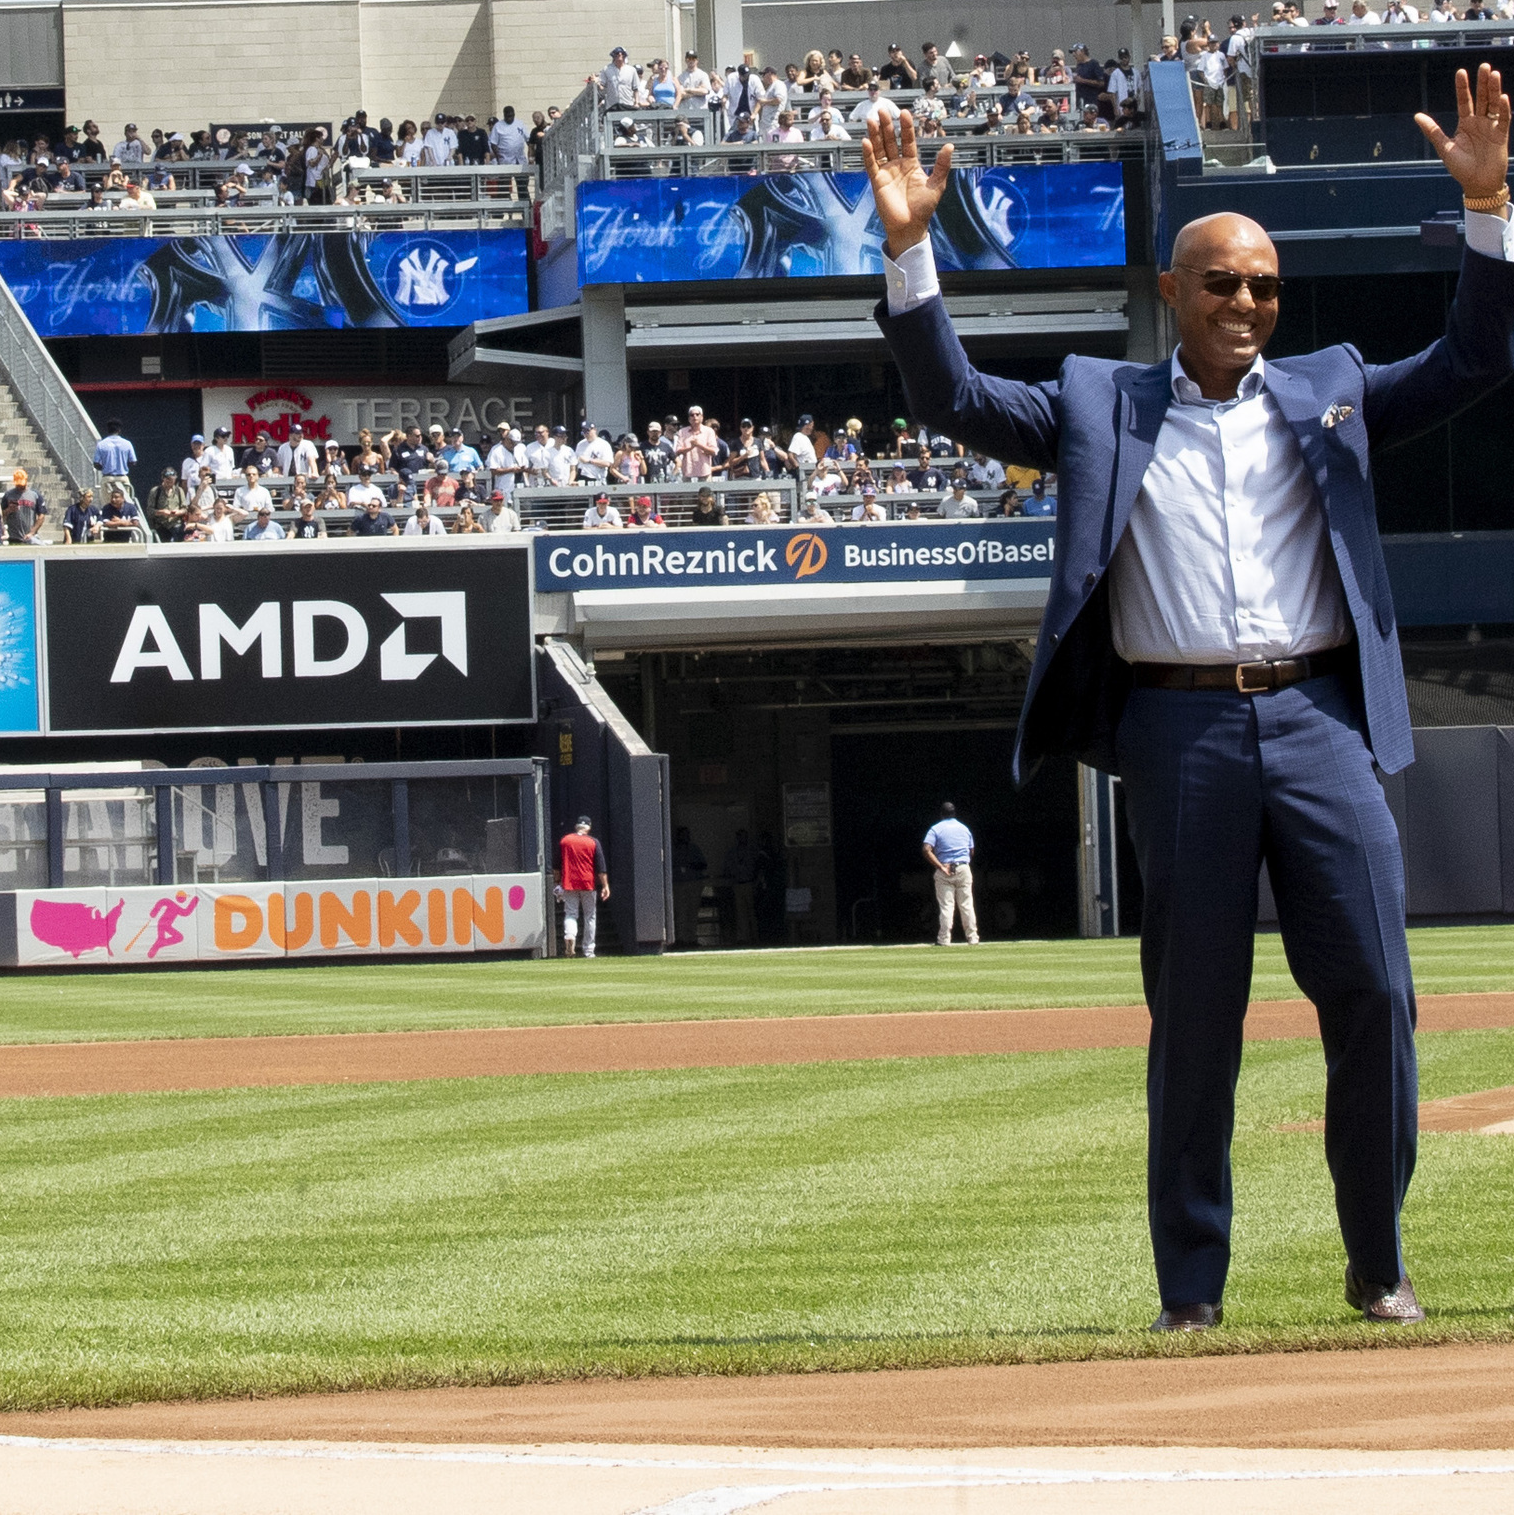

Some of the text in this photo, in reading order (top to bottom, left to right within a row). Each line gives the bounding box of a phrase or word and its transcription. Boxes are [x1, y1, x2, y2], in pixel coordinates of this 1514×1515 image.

[339, 397, 533, 434] TERRACE
[548, 541, 778, 579] CohnReznick
[110, 599, 370, 683] AMD
[214, 884, 526, 952] DUNKIN'
